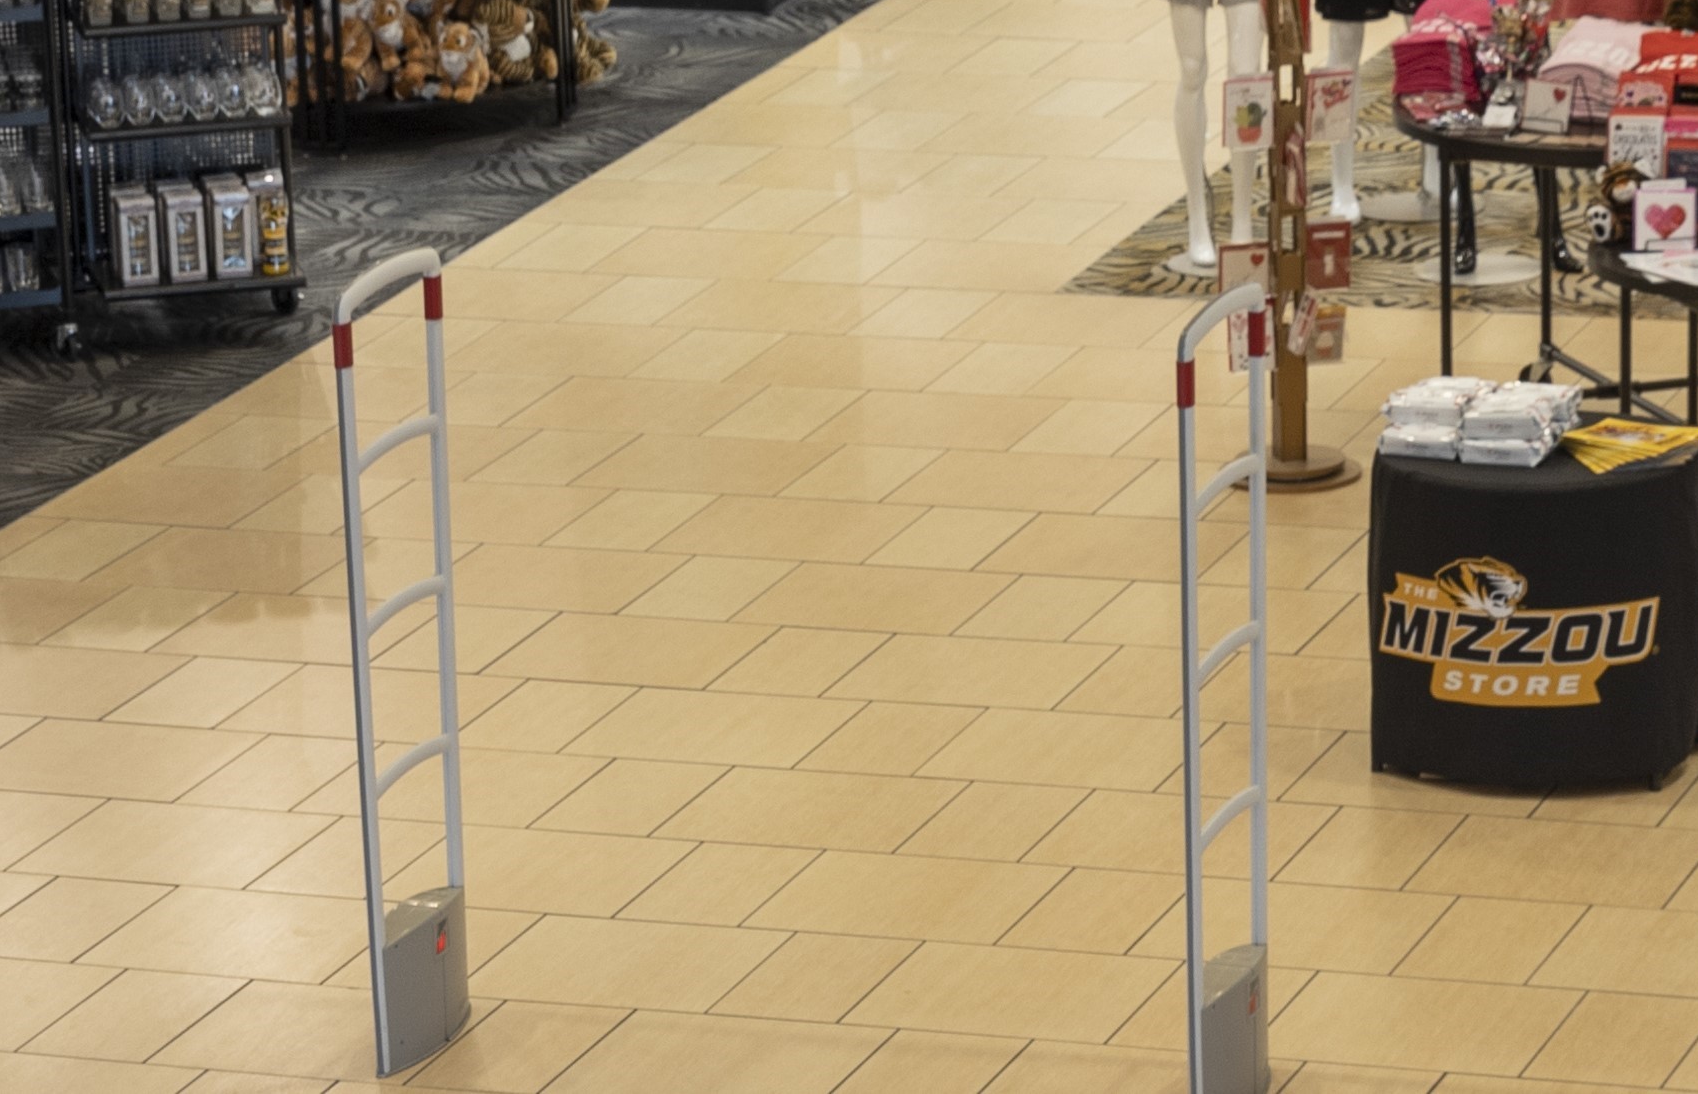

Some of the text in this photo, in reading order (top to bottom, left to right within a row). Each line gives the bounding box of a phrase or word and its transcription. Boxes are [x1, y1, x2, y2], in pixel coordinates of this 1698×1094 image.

[1404, 582, 1439, 601] THE
[1383, 601, 1655, 668] MIZZOU
[1443, 670, 1582, 697] STORE
